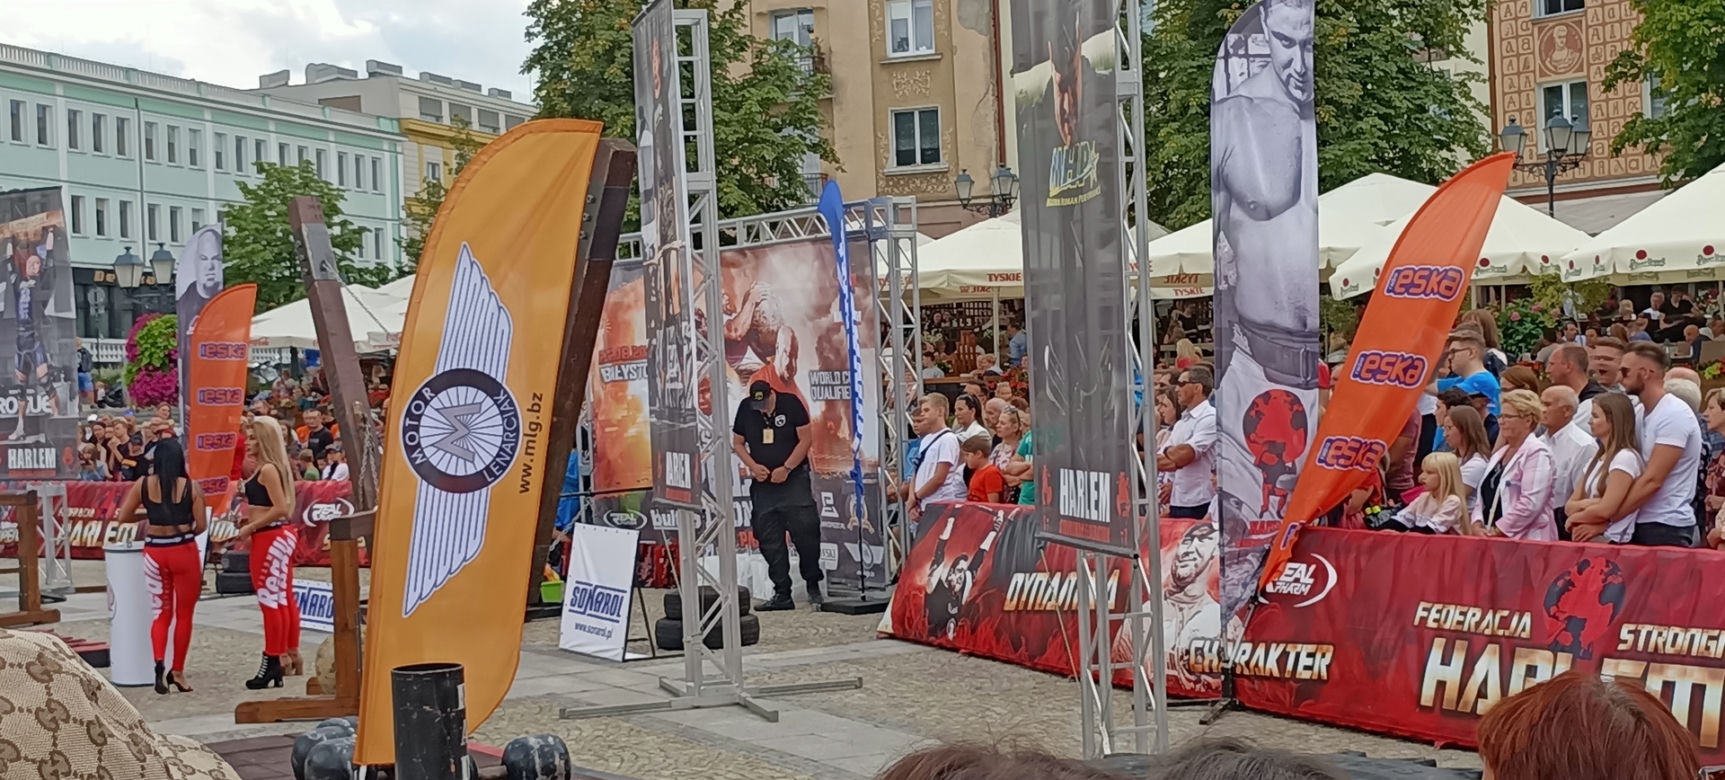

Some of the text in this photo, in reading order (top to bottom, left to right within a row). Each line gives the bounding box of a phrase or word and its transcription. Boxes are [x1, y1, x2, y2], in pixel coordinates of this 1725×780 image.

[987, 272, 1022, 282] TYSKIE
[1396, 266, 1461, 299] eska
[809, 371, 840, 385] WORLD
[1360, 353, 1425, 385] eska
[810, 386, 851, 401] QUALIFIE
[405, 386, 436, 465] MOTOR
[473, 388, 517, 482] LENARCIAK
[8, 447, 56, 469] HARLEM
[519, 392, 543, 494] www.mlg.bz
[1060, 468, 1110, 523] HARLEM
[1278, 562, 1316, 583] EAL
[294, 590, 334, 619] ONARO
[569, 584, 625, 619] SONAROL
[1413, 601, 1532, 638] FEDERACJA
[1617, 623, 1725, 659] STRONG
